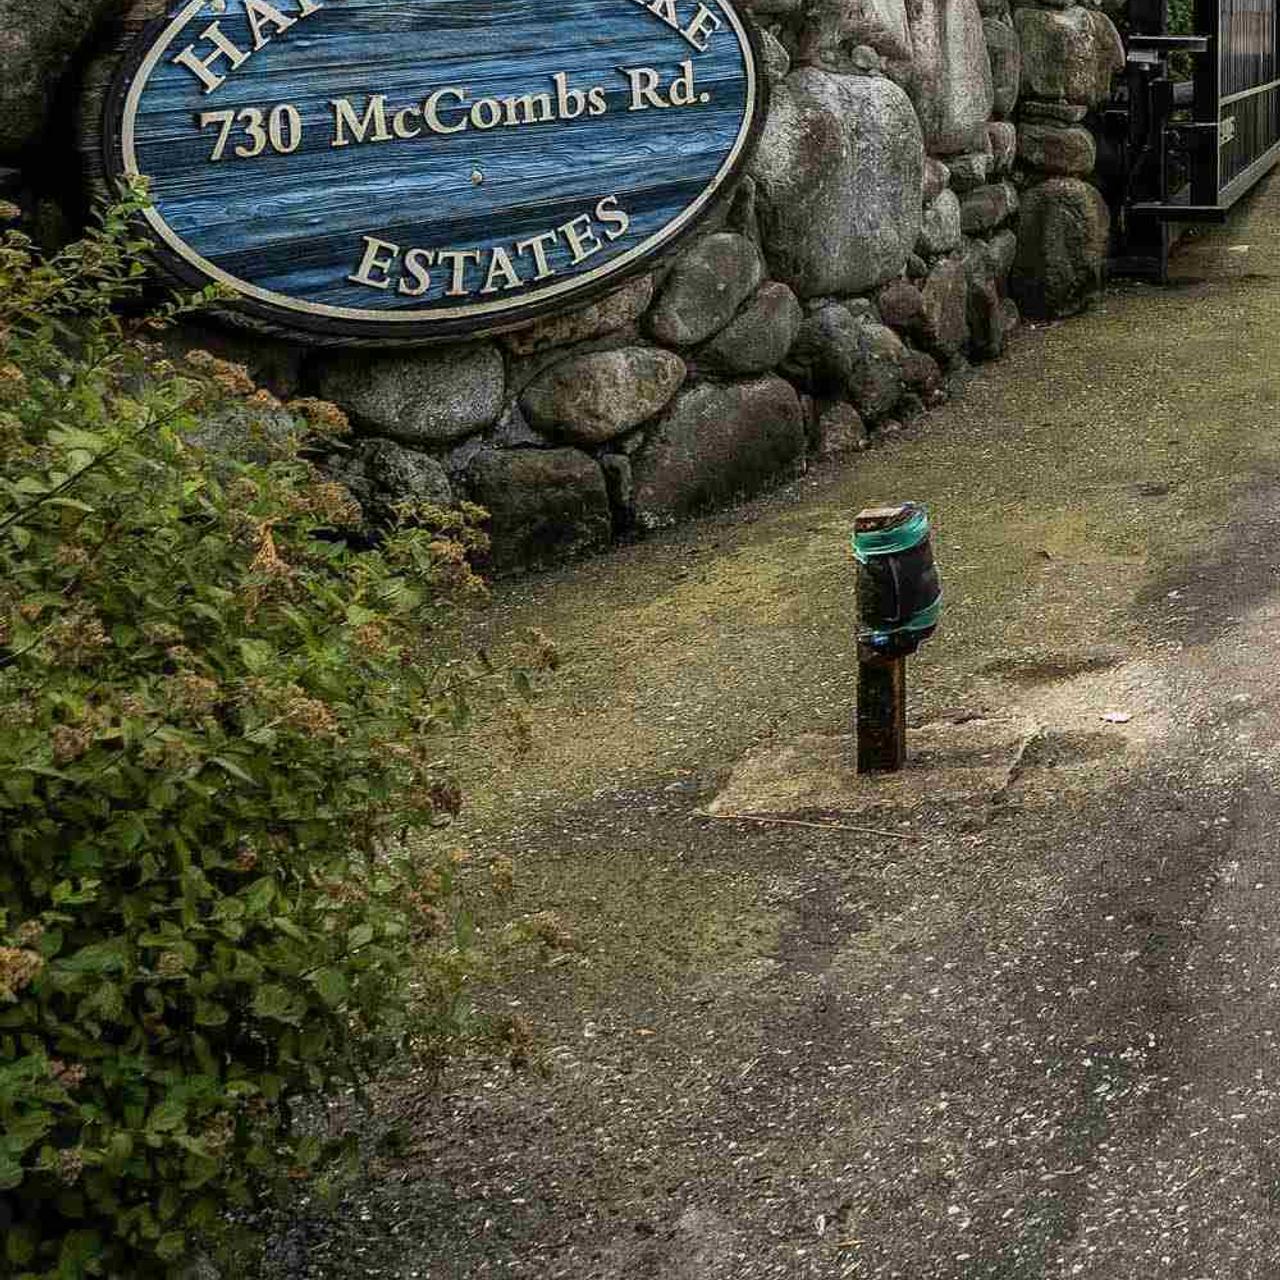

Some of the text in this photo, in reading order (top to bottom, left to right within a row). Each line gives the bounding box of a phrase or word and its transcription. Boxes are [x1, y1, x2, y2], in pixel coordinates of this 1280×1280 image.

[201, 59, 711, 161] 730 McCombs Rd.
[347, 195, 631, 297] ESTATES
